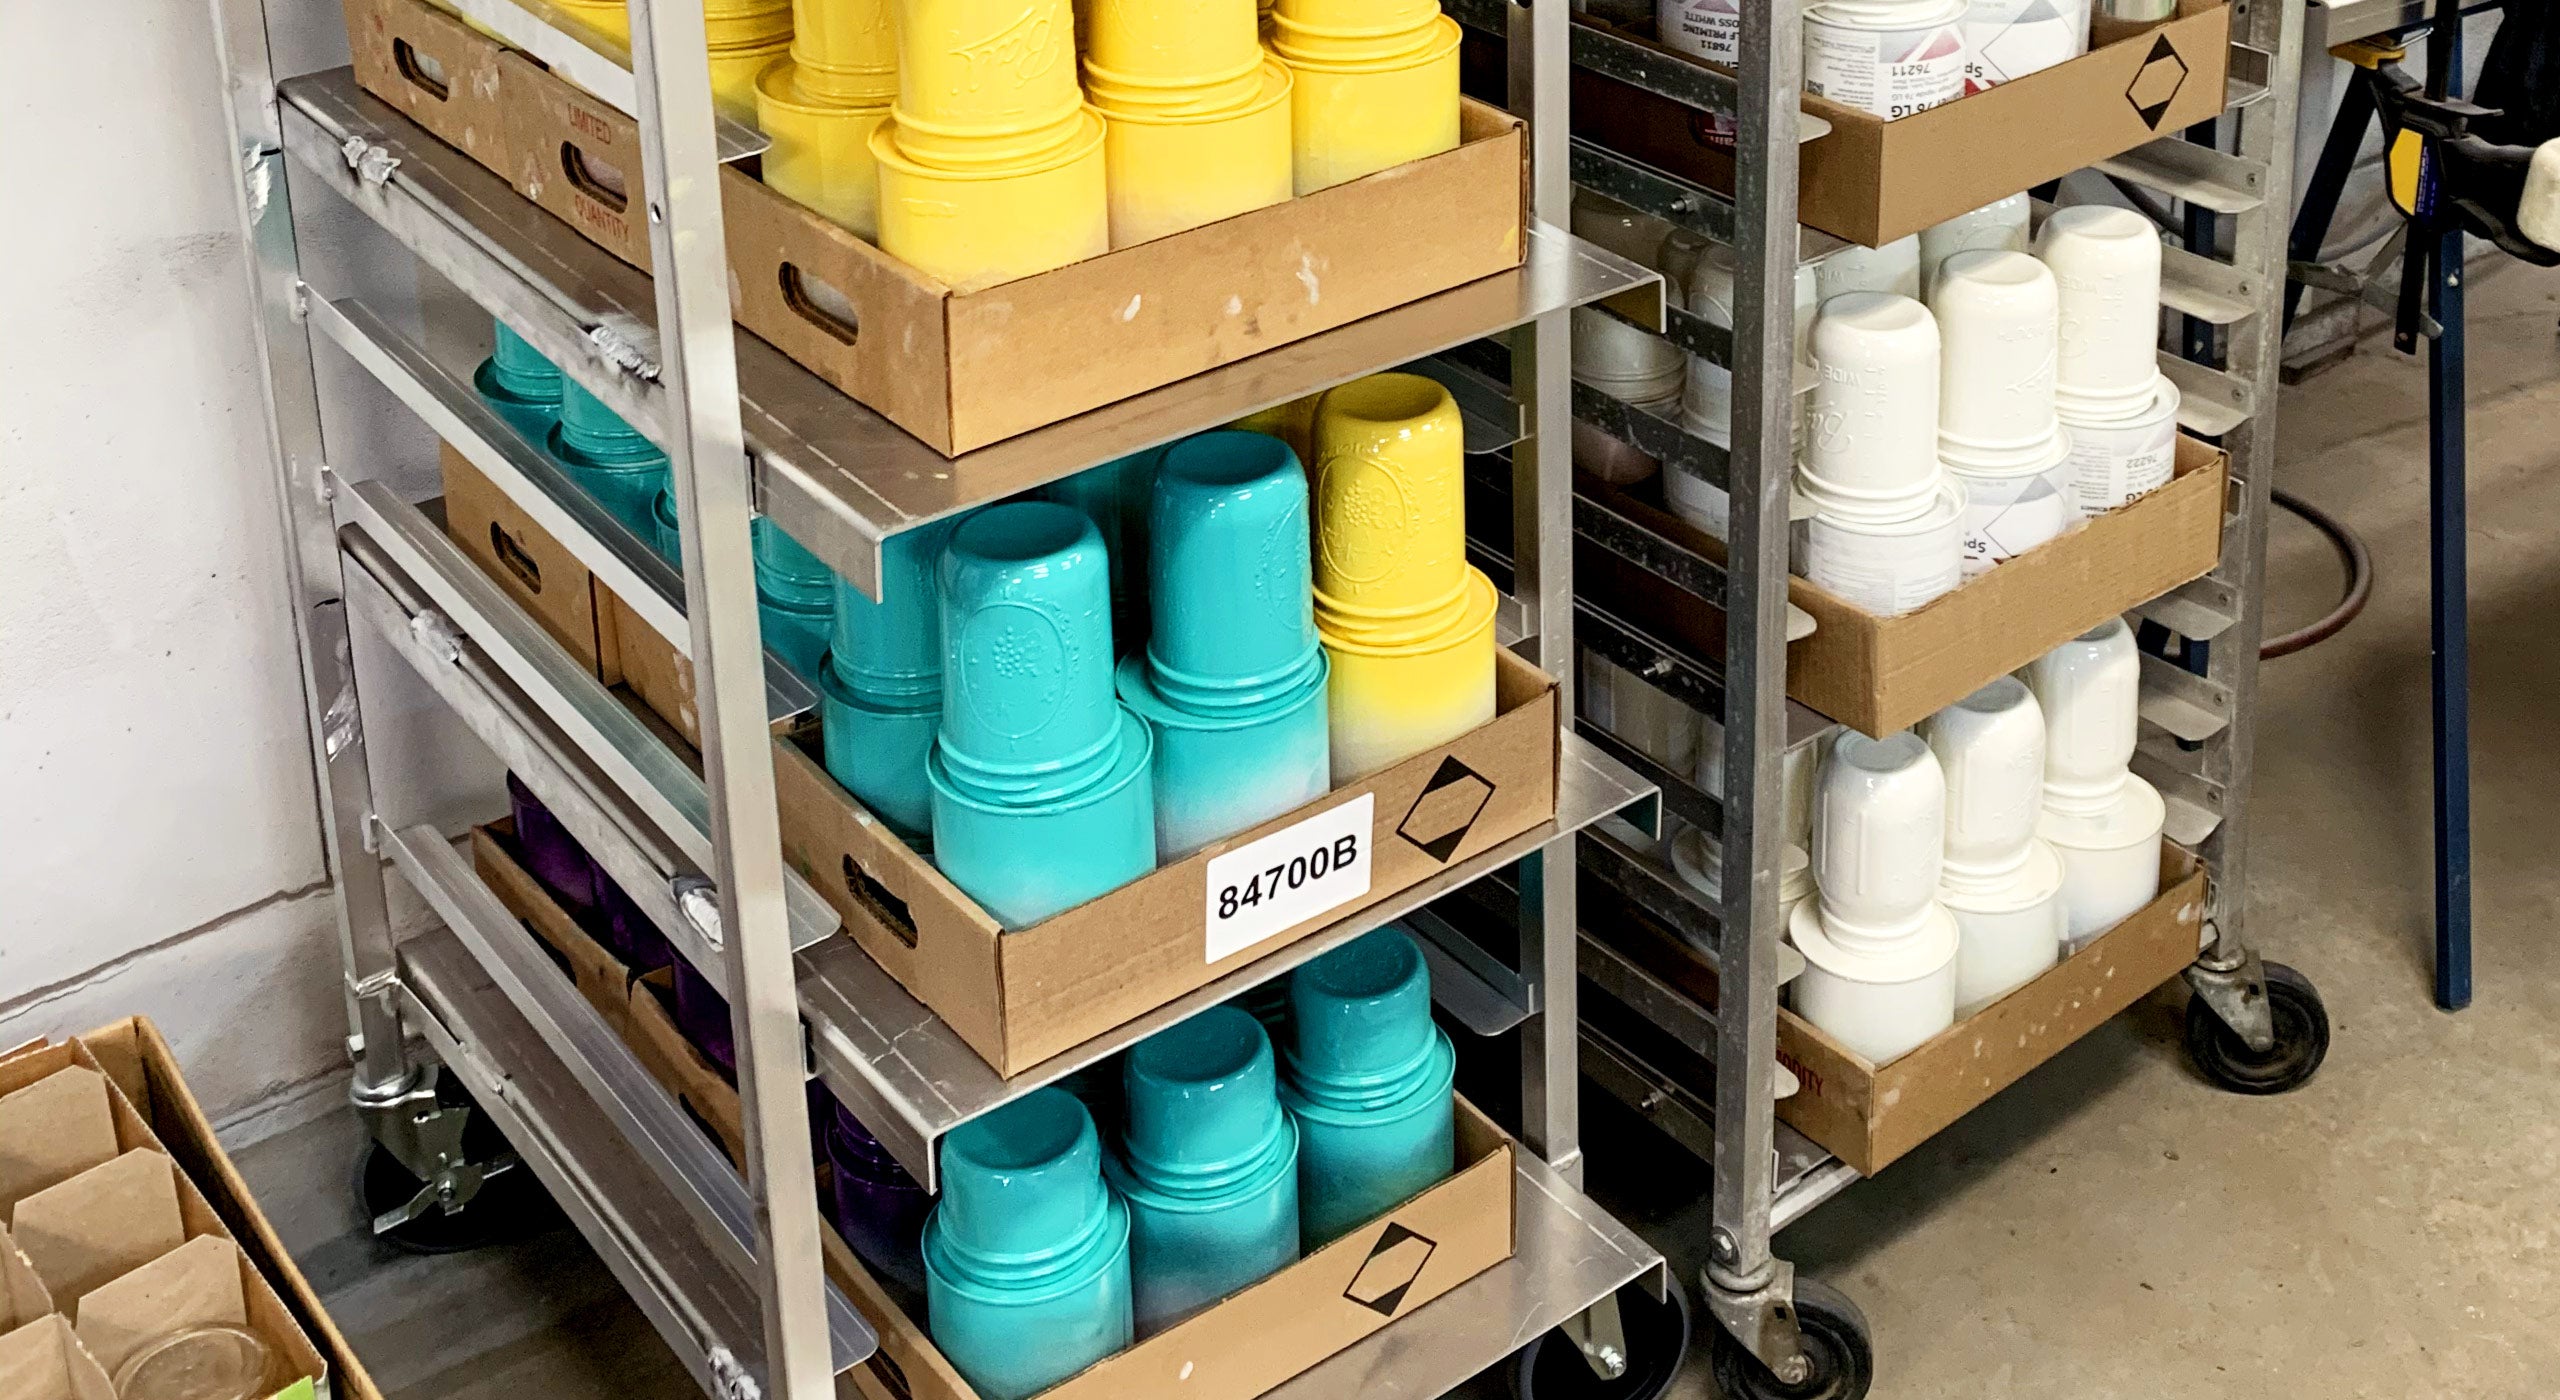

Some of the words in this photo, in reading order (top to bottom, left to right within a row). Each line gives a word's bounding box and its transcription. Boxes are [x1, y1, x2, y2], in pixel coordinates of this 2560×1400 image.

[1684, 11, 1715, 27] WHITE
[1683, 23, 1727, 40] PRIMING
[1701, 40, 1732, 53] 76811
[1892, 63, 1931, 77] 76211
[1891, 105, 1911, 118] LG
[568, 102, 612, 145] LIMITED
[575, 194, 630, 243] QUANTITY
[1823, 364, 1861, 389] WIDE
[2126, 453, 2158, 468] 76222
[1218, 833, 1358, 920] 84700B
